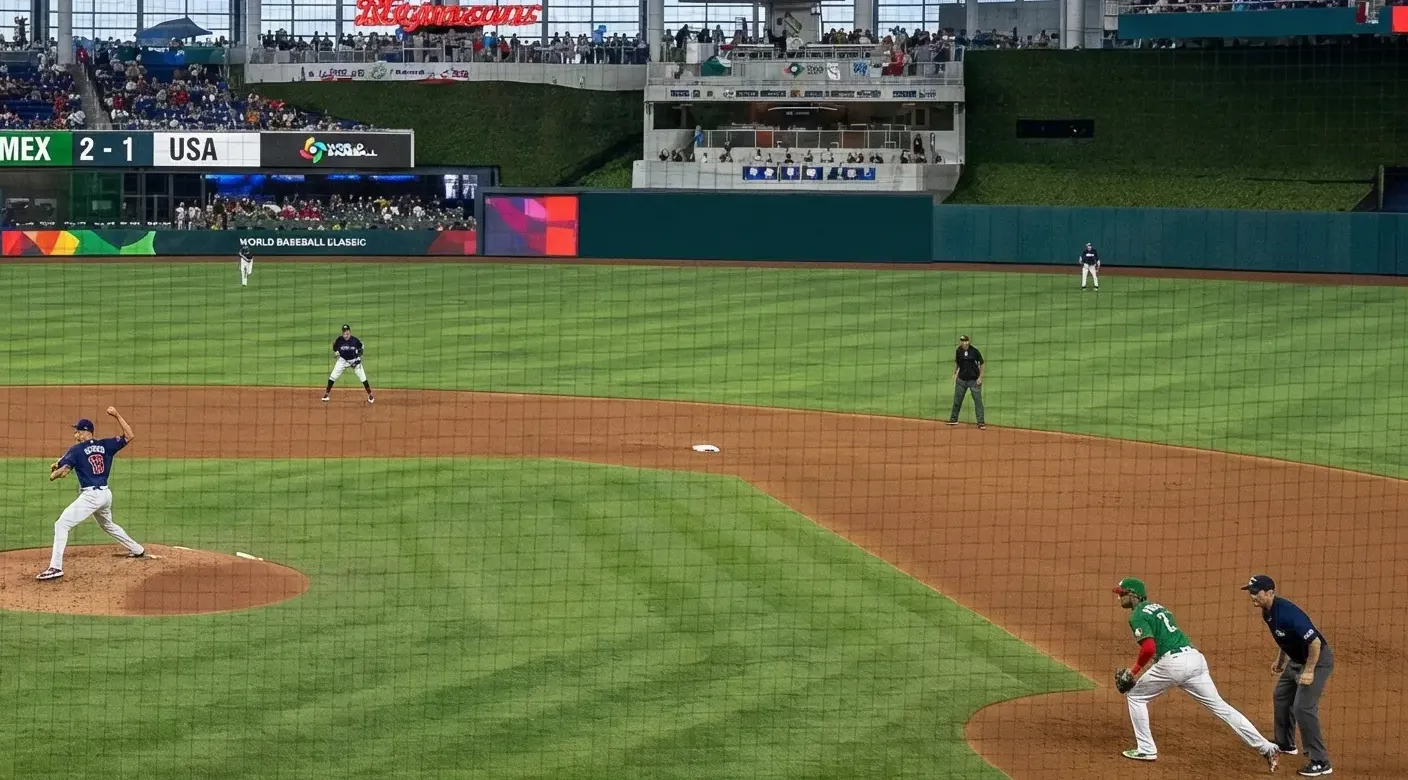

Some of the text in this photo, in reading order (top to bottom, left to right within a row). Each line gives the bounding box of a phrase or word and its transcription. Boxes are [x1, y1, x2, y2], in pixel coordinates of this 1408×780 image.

[79, 136, 94, 161] 2
[122, 136, 133, 161] 1
[169, 136, 218, 161] USA
[239, 237, 275, 247] WORLD
